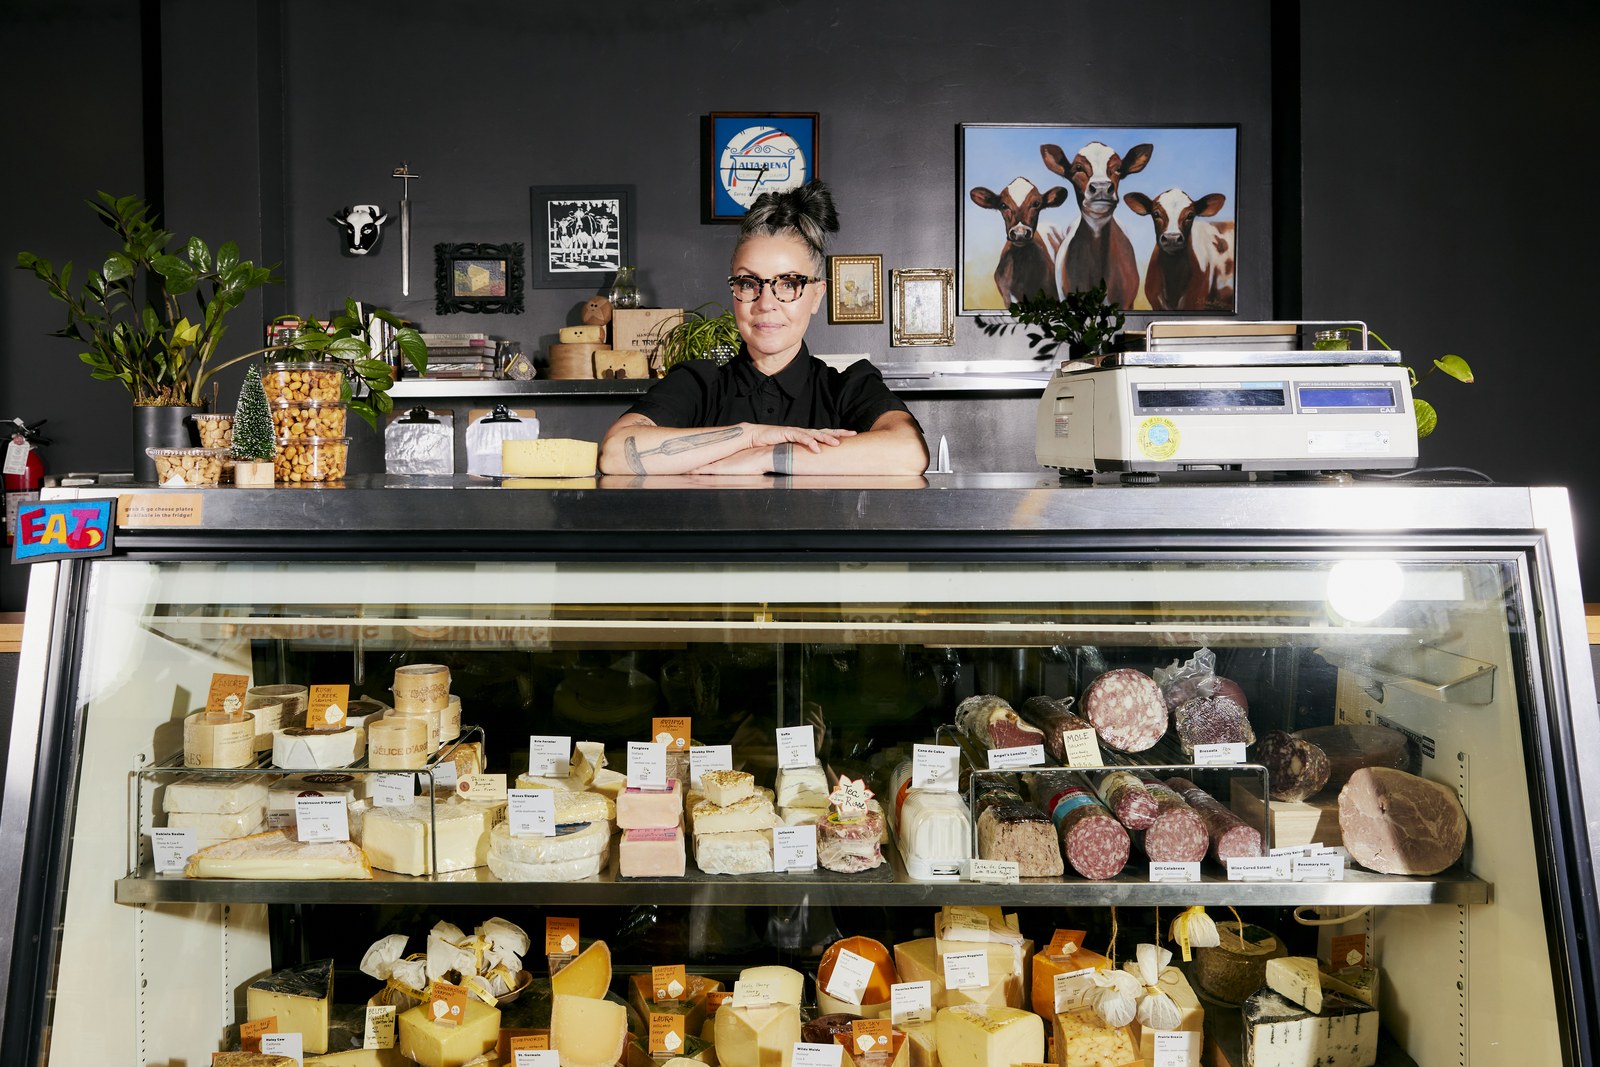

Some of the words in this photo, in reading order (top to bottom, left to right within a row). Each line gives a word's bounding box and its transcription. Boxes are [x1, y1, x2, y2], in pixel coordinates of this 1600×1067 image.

[20, 508, 100, 545] EAT
[1067, 732, 1089, 742] MOLE
[373, 744, 404, 755] DÉLICE
[843, 784, 859, 798] Tea
[845, 797, 866, 810] Rose
[653, 1015, 674, 1023] LAURA
